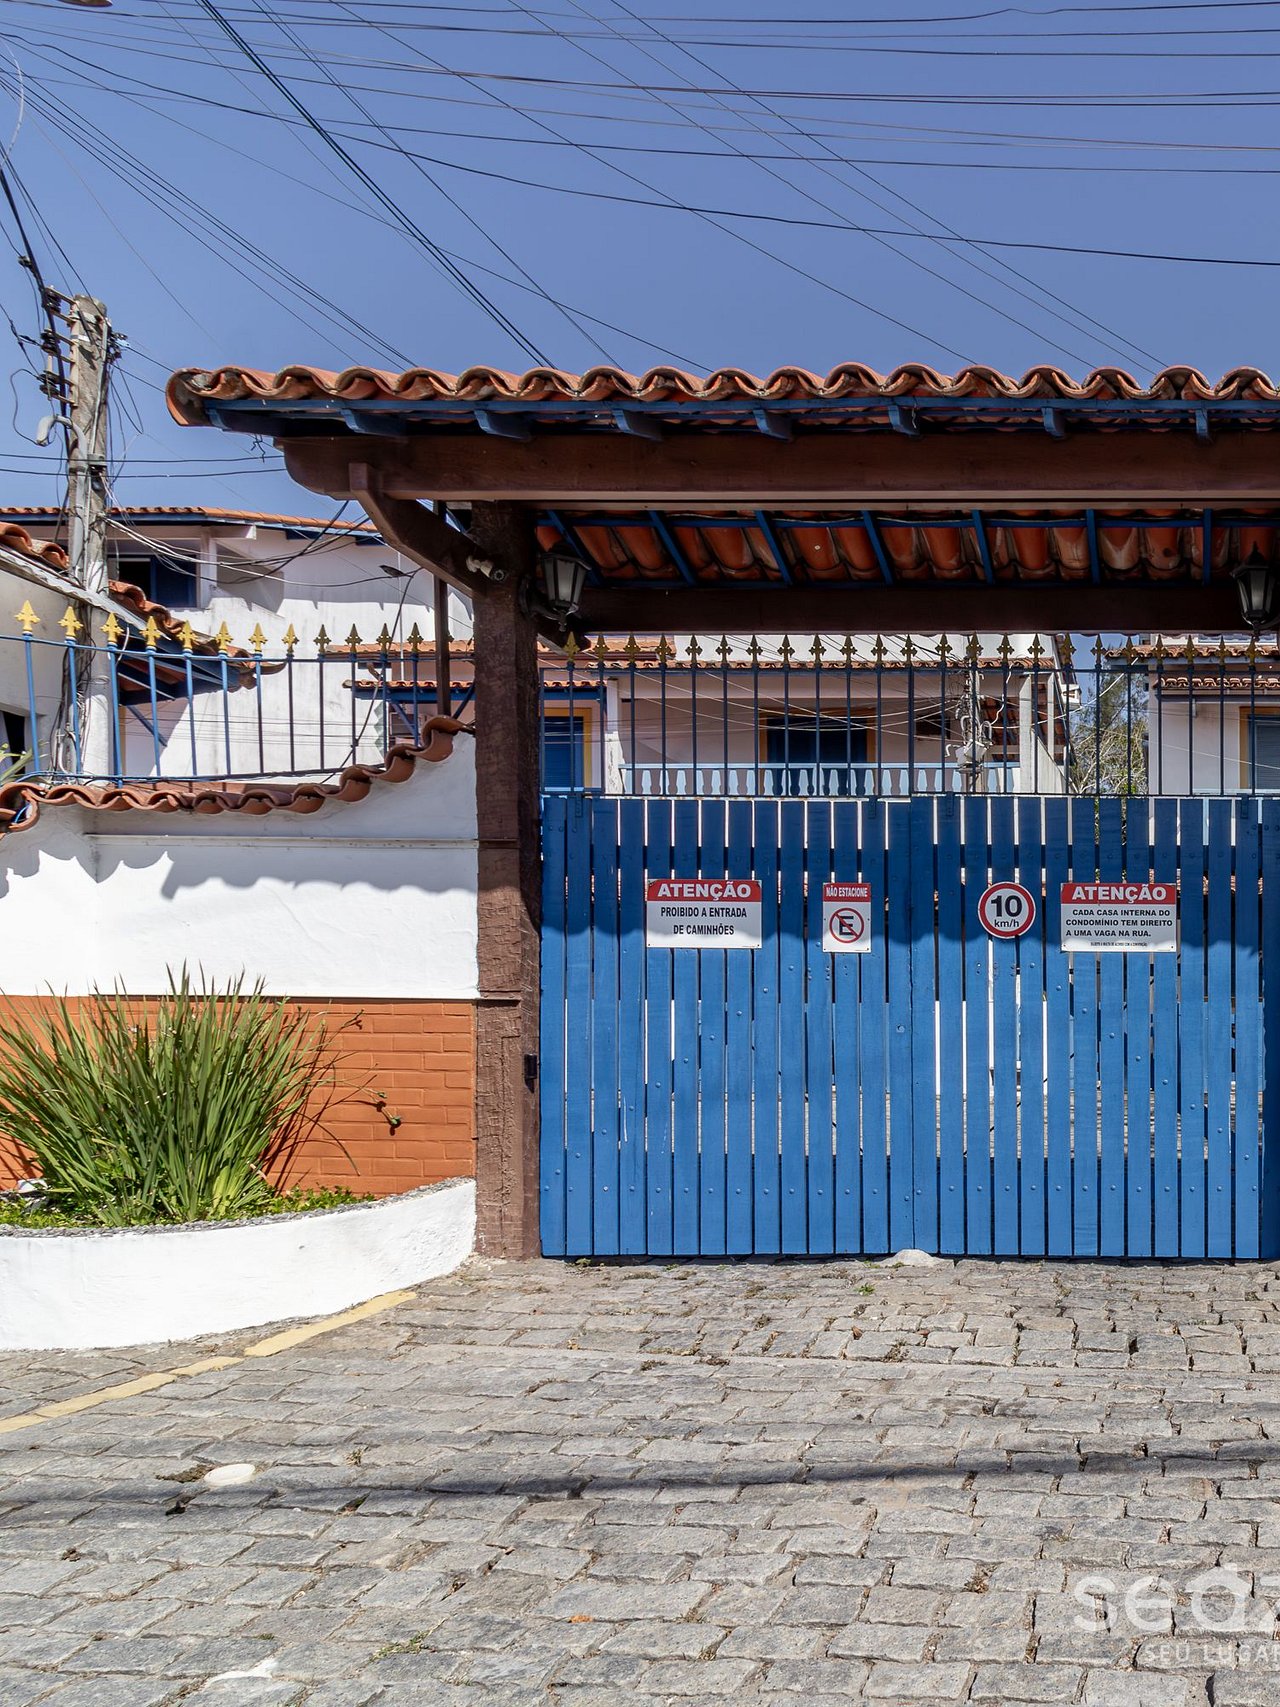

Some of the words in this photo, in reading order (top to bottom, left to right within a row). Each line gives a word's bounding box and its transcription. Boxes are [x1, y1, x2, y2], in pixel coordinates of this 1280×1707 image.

[657, 881, 751, 901] ATENÇÃO
[826, 885, 838, 897] NÃO
[838, 887, 868, 897] ESTACIONE
[1071, 884, 1167, 904] ATENÇÃO
[990, 894, 1023, 918] 10
[660, 907, 700, 918] PROIBIDO
[701, 907, 708, 917] A
[709, 907, 747, 918] ENTRADA
[1072, 909, 1095, 917] CADA
[1158, 909, 1171, 917] DO
[994, 918, 1020, 929] km/h
[1065, 918, 1119, 926] CONDOMÍNIO
[673, 925, 685, 935] DE
[686, 923, 734, 935] CAMINHÕES
